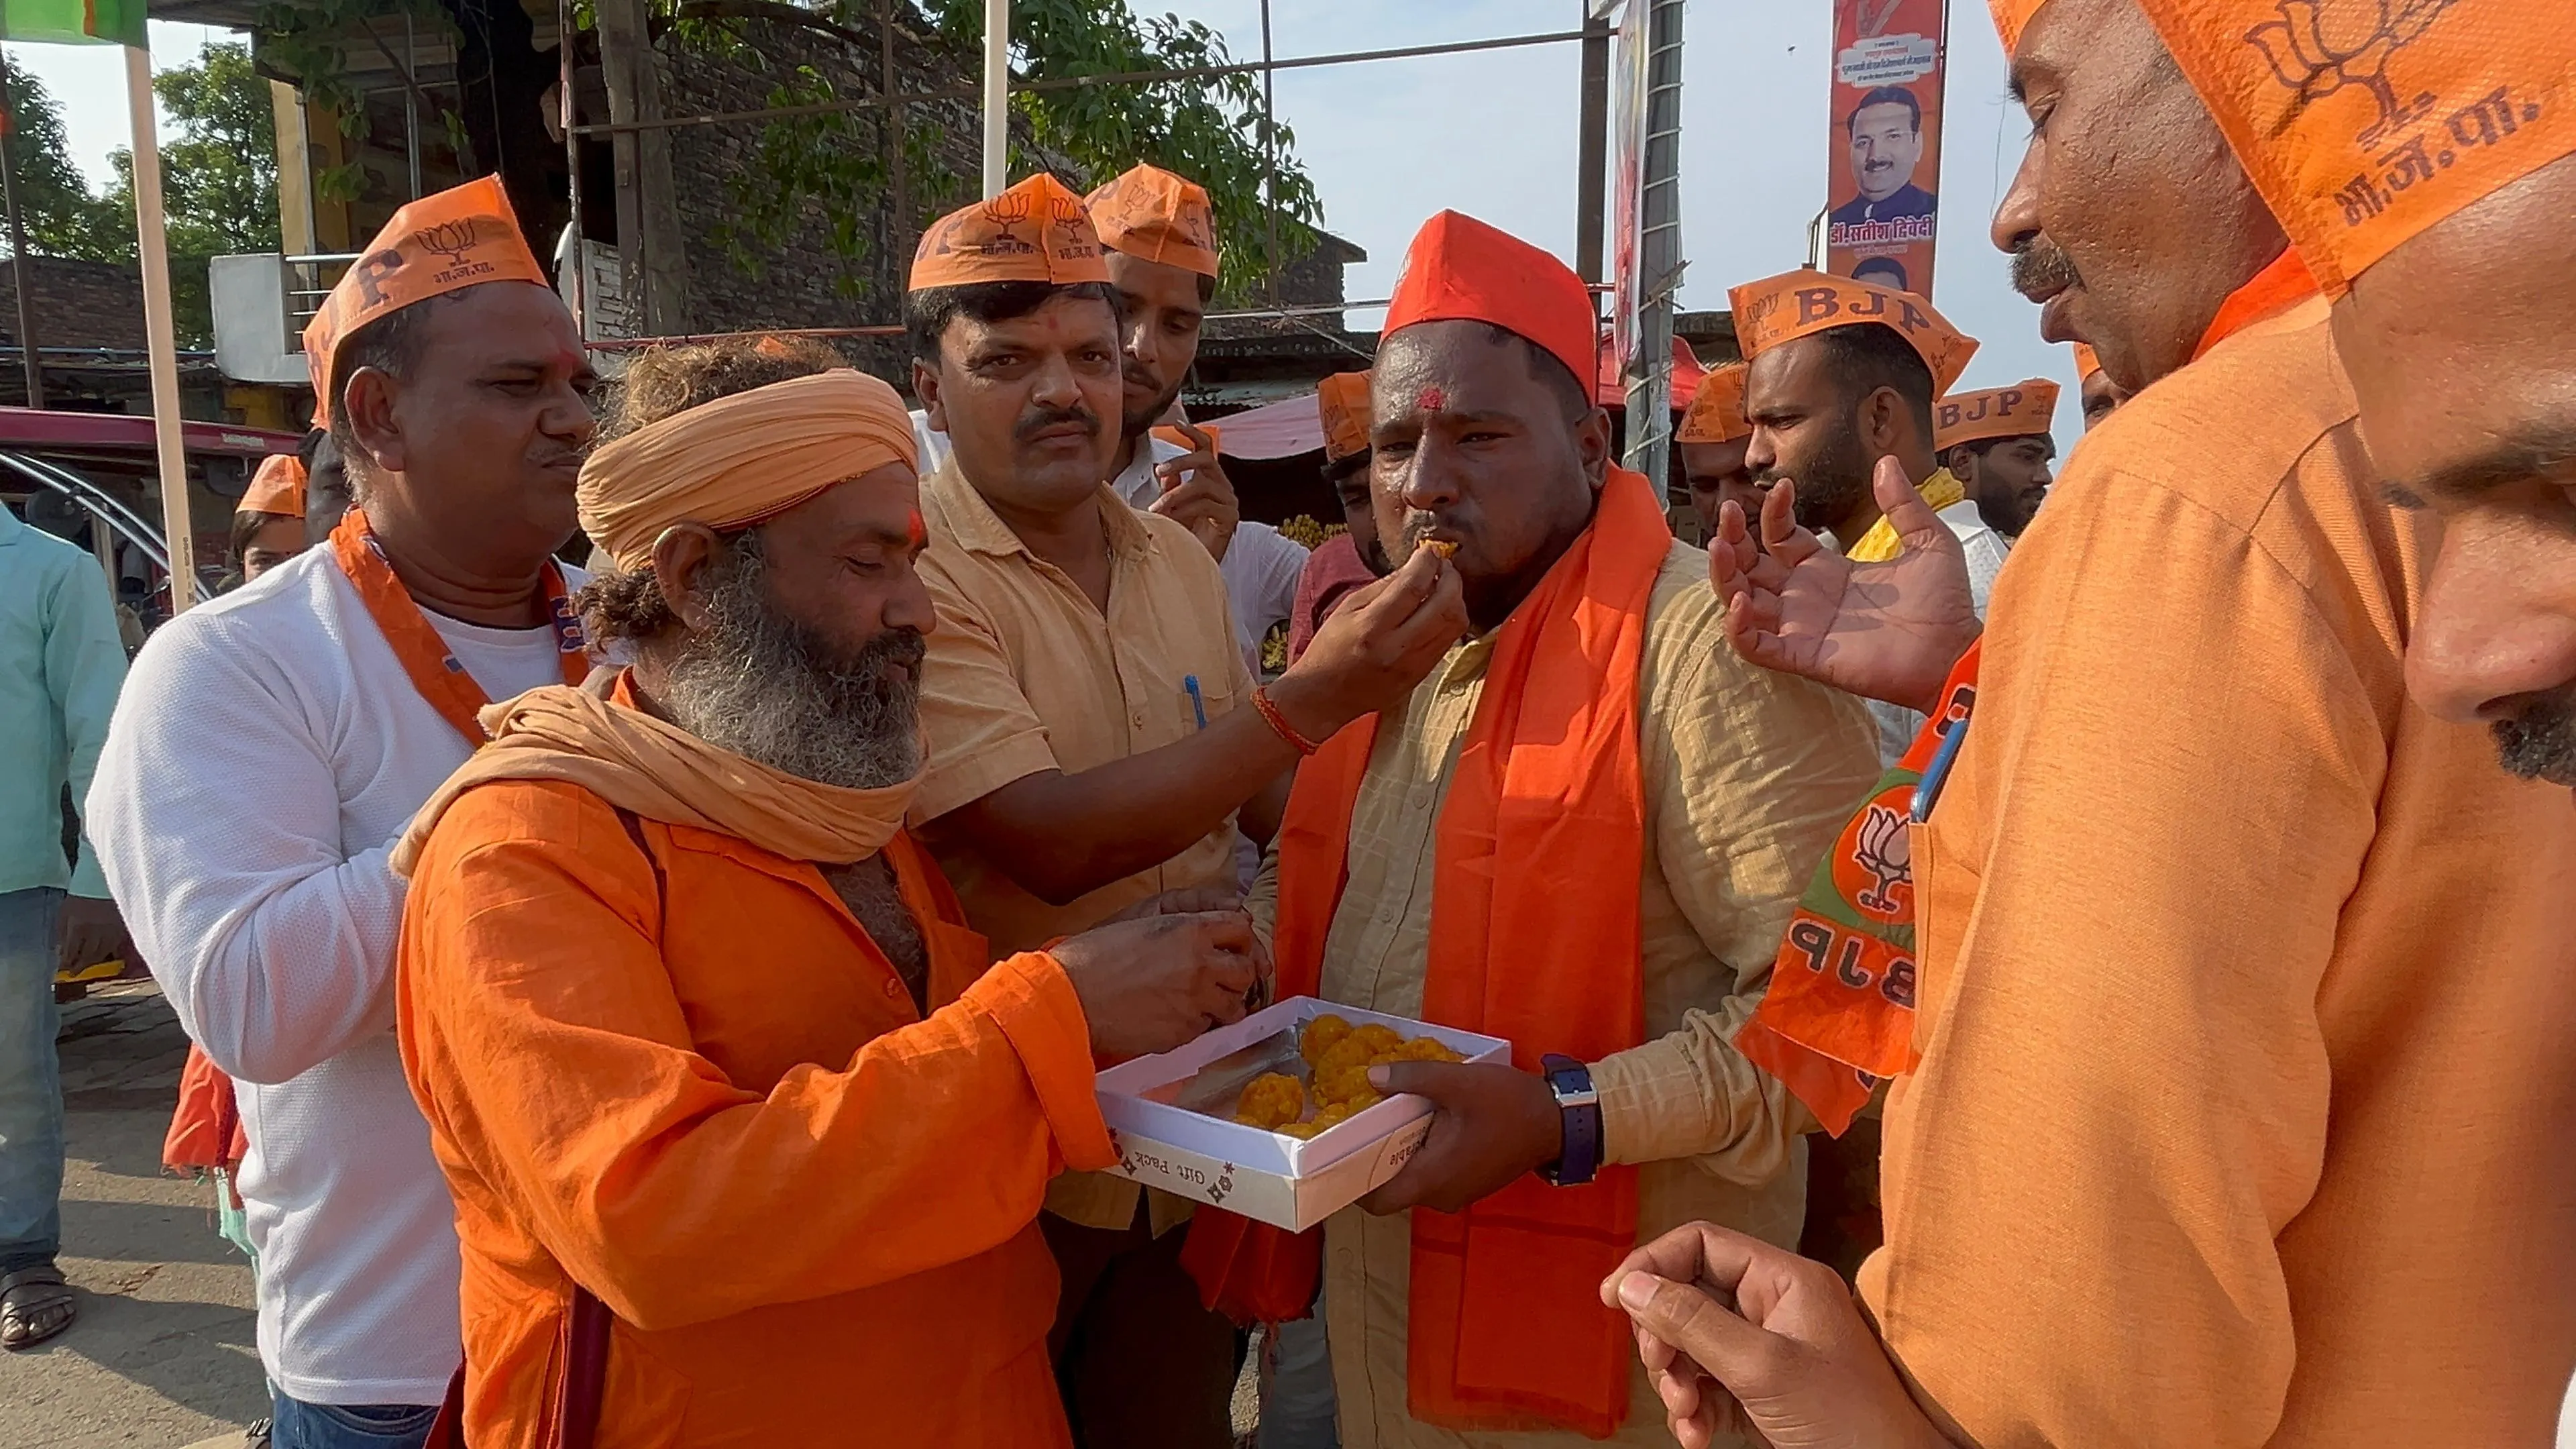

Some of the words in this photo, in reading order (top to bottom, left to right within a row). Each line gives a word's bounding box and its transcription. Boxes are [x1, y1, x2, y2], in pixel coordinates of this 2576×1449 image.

[1794, 286, 1931, 335] BJP
[1937, 390, 2023, 430] BJP
[1134, 1151, 1170, 1174] Pack
[1177, 1164, 1205, 1185] Gift
